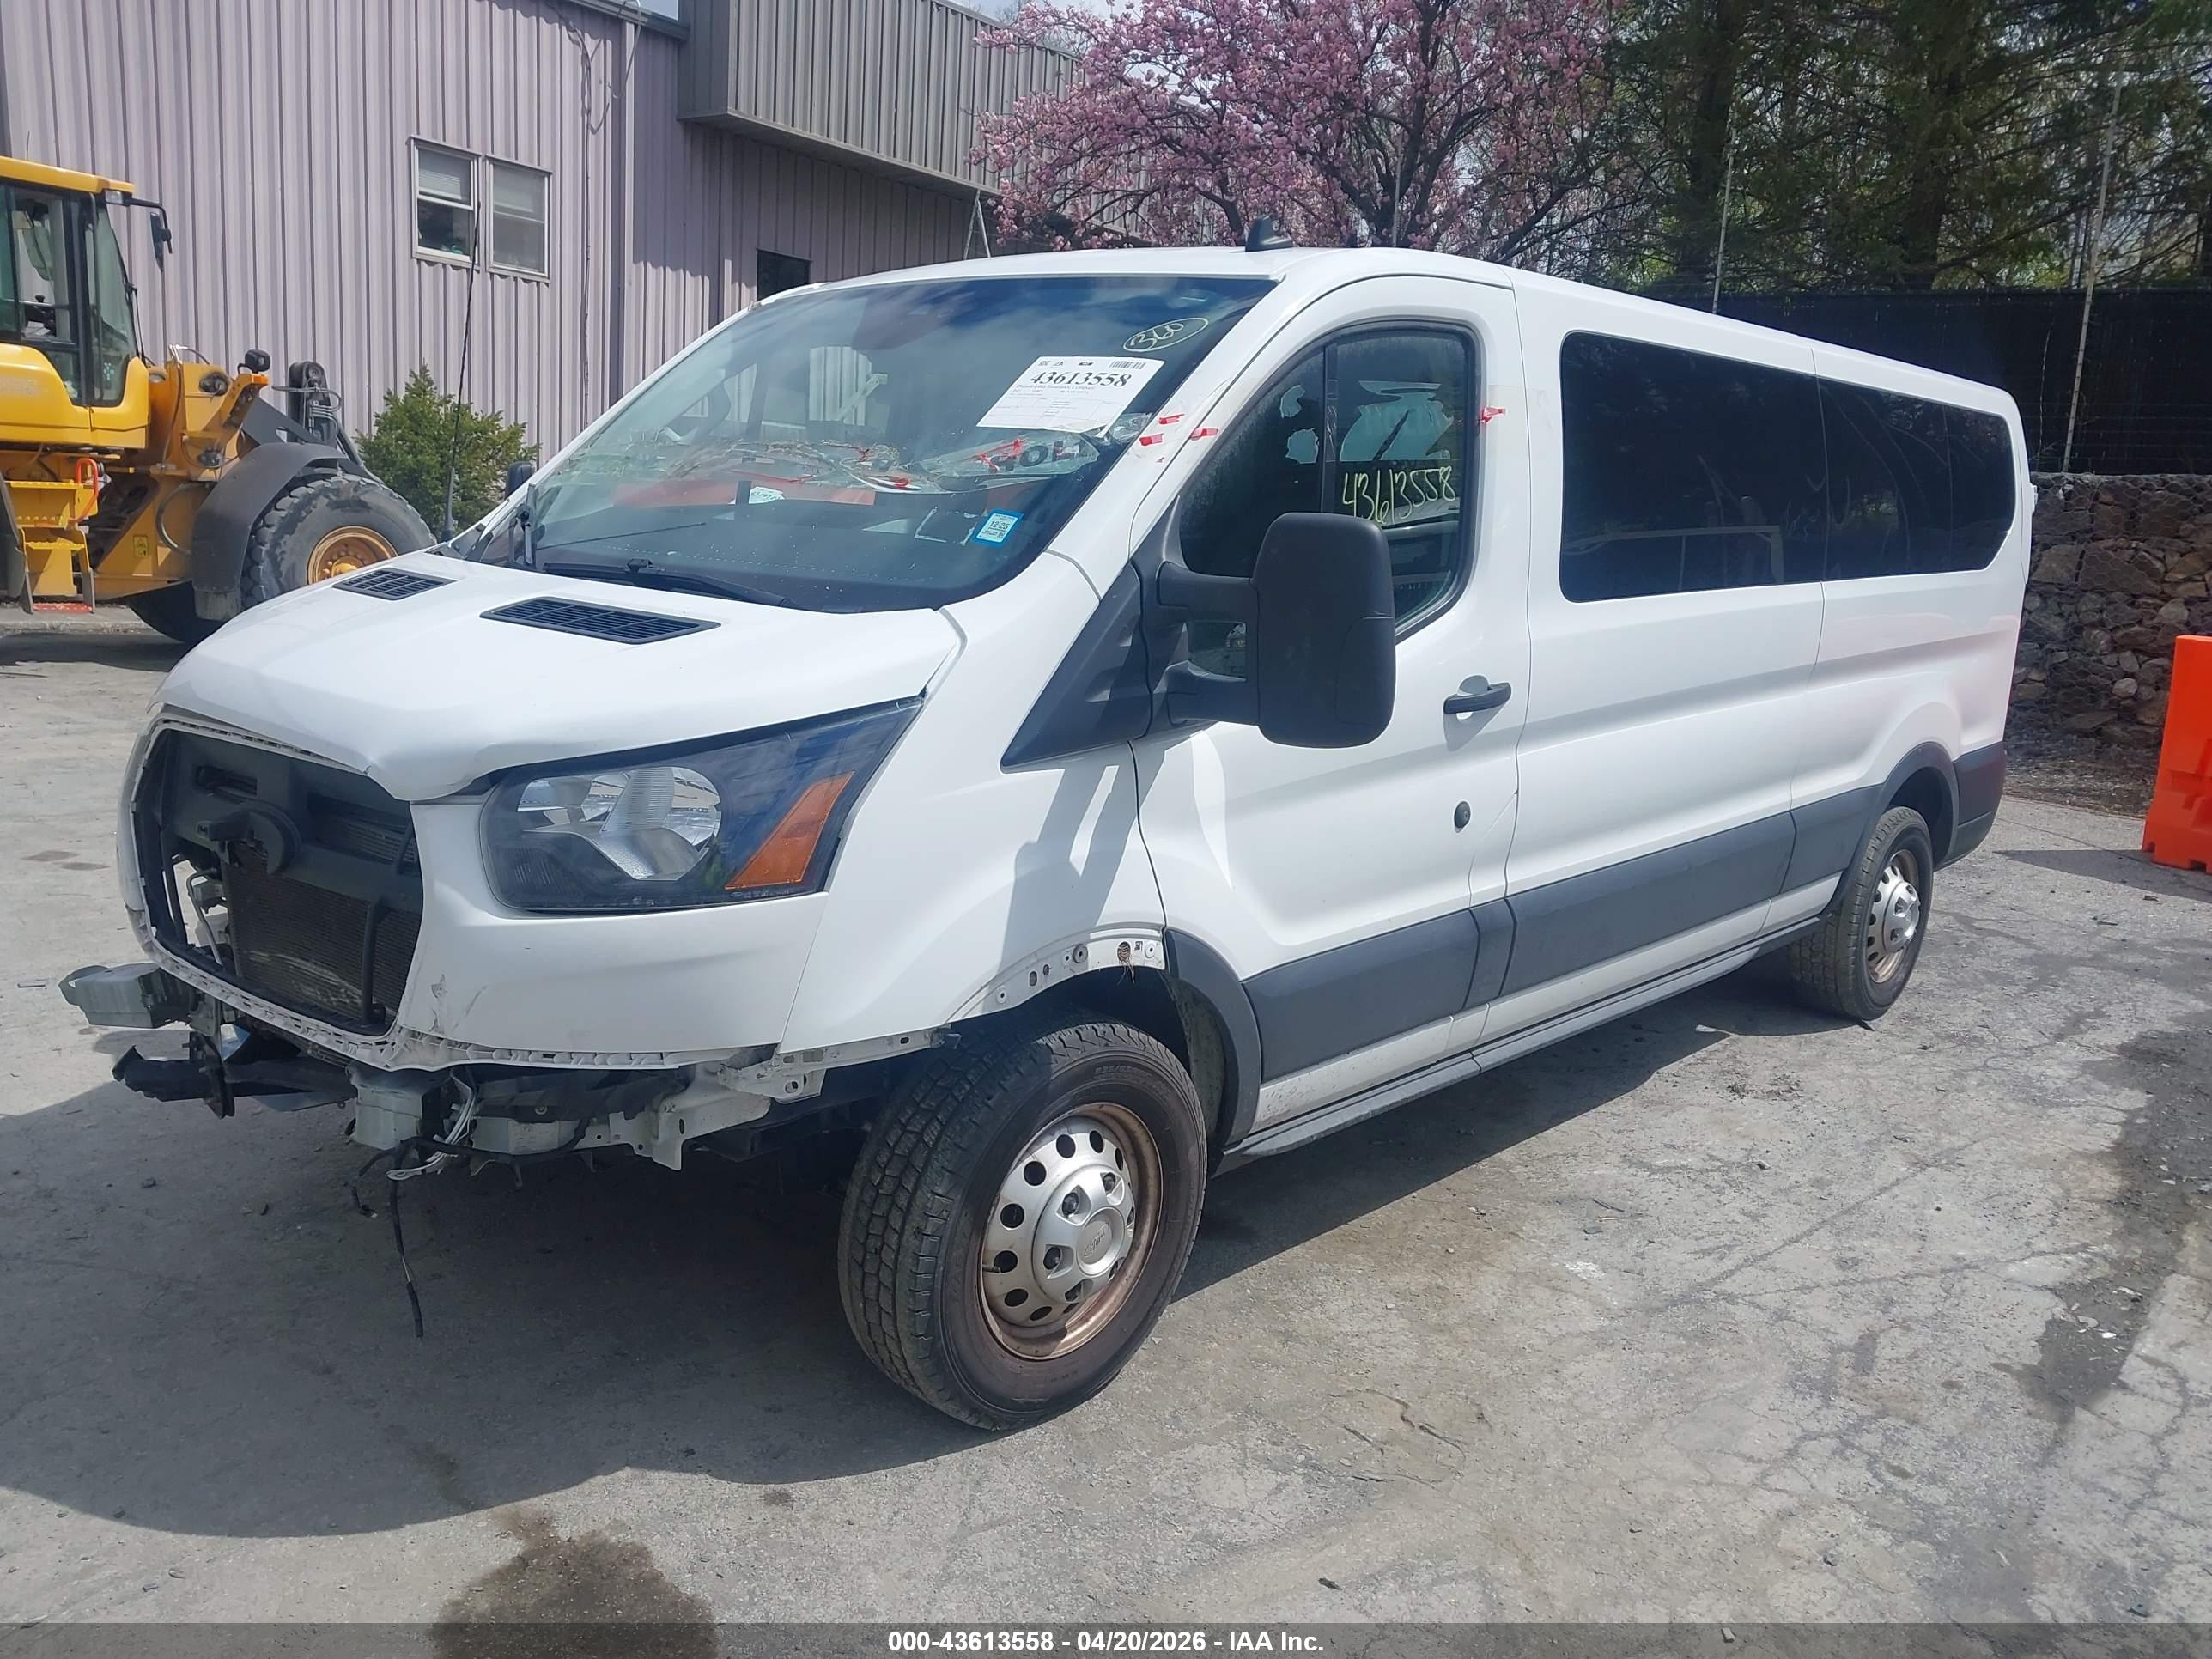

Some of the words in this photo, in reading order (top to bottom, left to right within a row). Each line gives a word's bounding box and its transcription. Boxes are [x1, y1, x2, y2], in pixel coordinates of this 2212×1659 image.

[1130, 323, 1184, 350] 360
[1030, 371, 1132, 387] 43613558
[1342, 465, 1456, 525] 43613558
